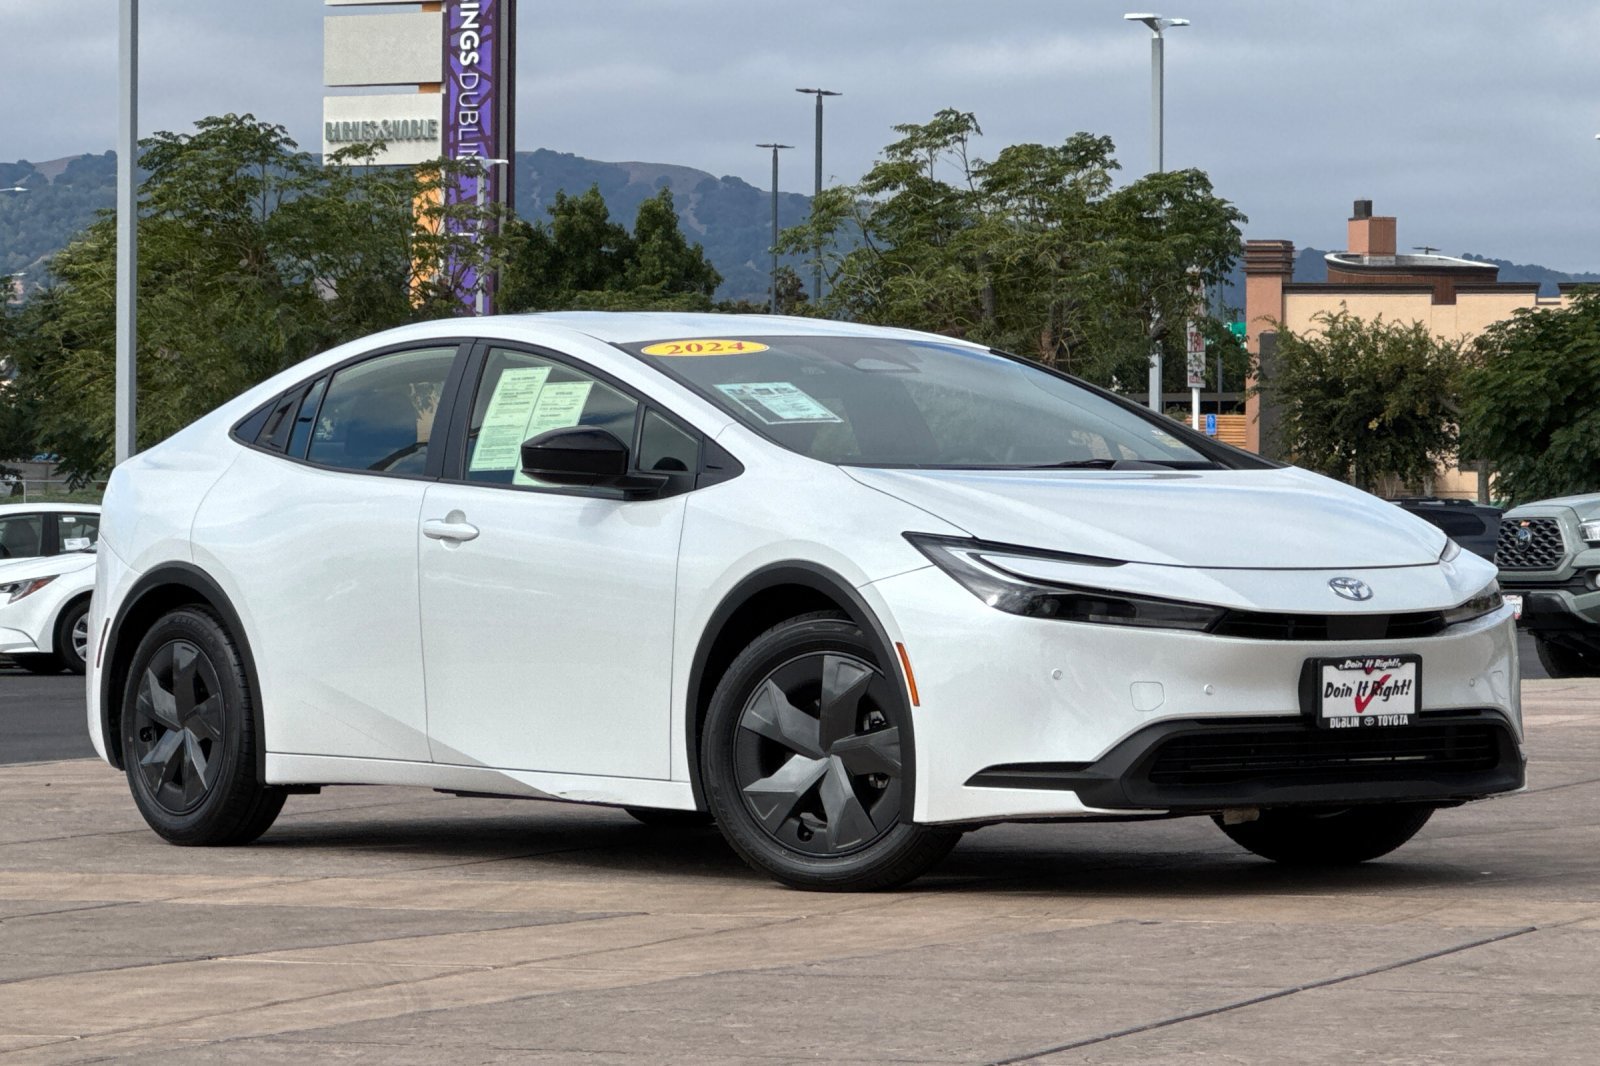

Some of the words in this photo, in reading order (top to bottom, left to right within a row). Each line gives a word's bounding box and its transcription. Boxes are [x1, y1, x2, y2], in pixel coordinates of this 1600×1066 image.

[459, 0, 480, 66] INGS
[665, 342, 745, 355] 2024
[1356, 681, 1369, 697] It
[1370, 679, 1412, 702] Right!
[1330, 717, 1360, 729] DUBLIN
[1377, 715, 1409, 727] TOYOTA
